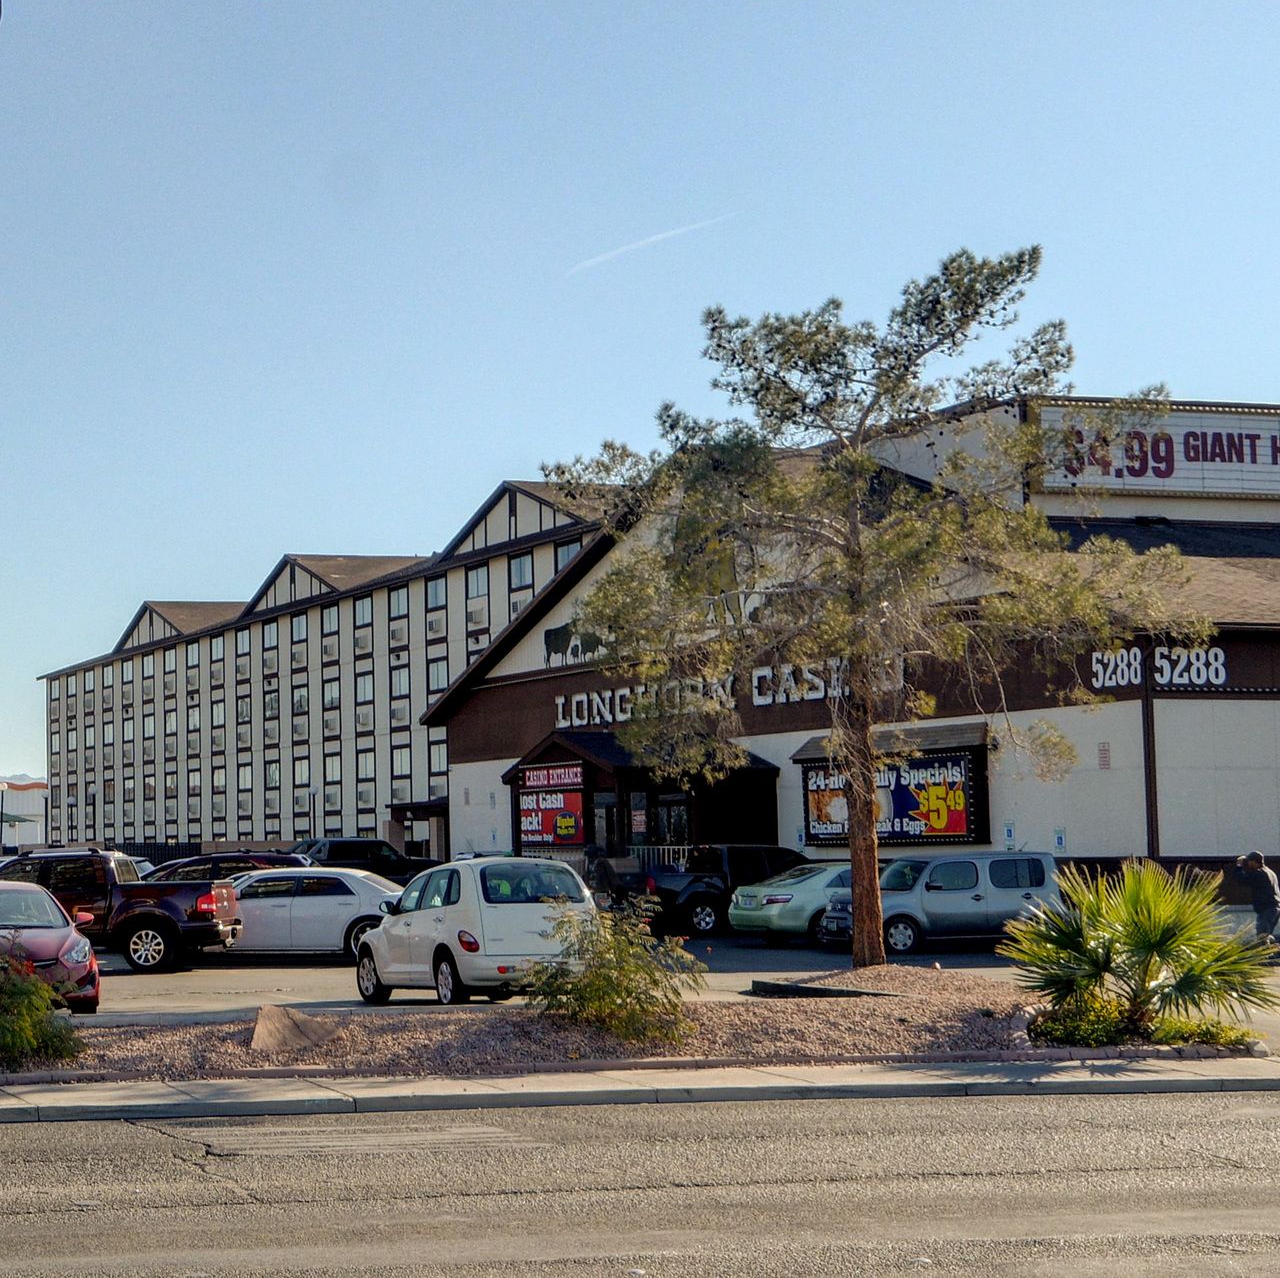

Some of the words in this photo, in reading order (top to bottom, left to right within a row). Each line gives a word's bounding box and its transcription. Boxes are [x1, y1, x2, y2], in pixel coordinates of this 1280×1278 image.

[1183, 430, 1261, 465] GIANT
[1091, 646, 1142, 689] 5288
[1153, 646, 1227, 685] 5288
[525, 769, 548, 786] CASINO
[549, 767, 583, 784] ENTRANCE
[808, 770, 847, 790] 24-Ho
[873, 767, 897, 790] aily
[900, 760, 966, 788] Specials!
[539, 792, 565, 809] Cash
[521, 811, 542, 831] ack!
[810, 820, 843, 834] Chicken
[876, 819, 893, 832] eak
[894, 818, 901, 831] &
[903, 818, 926, 835] Eggs
